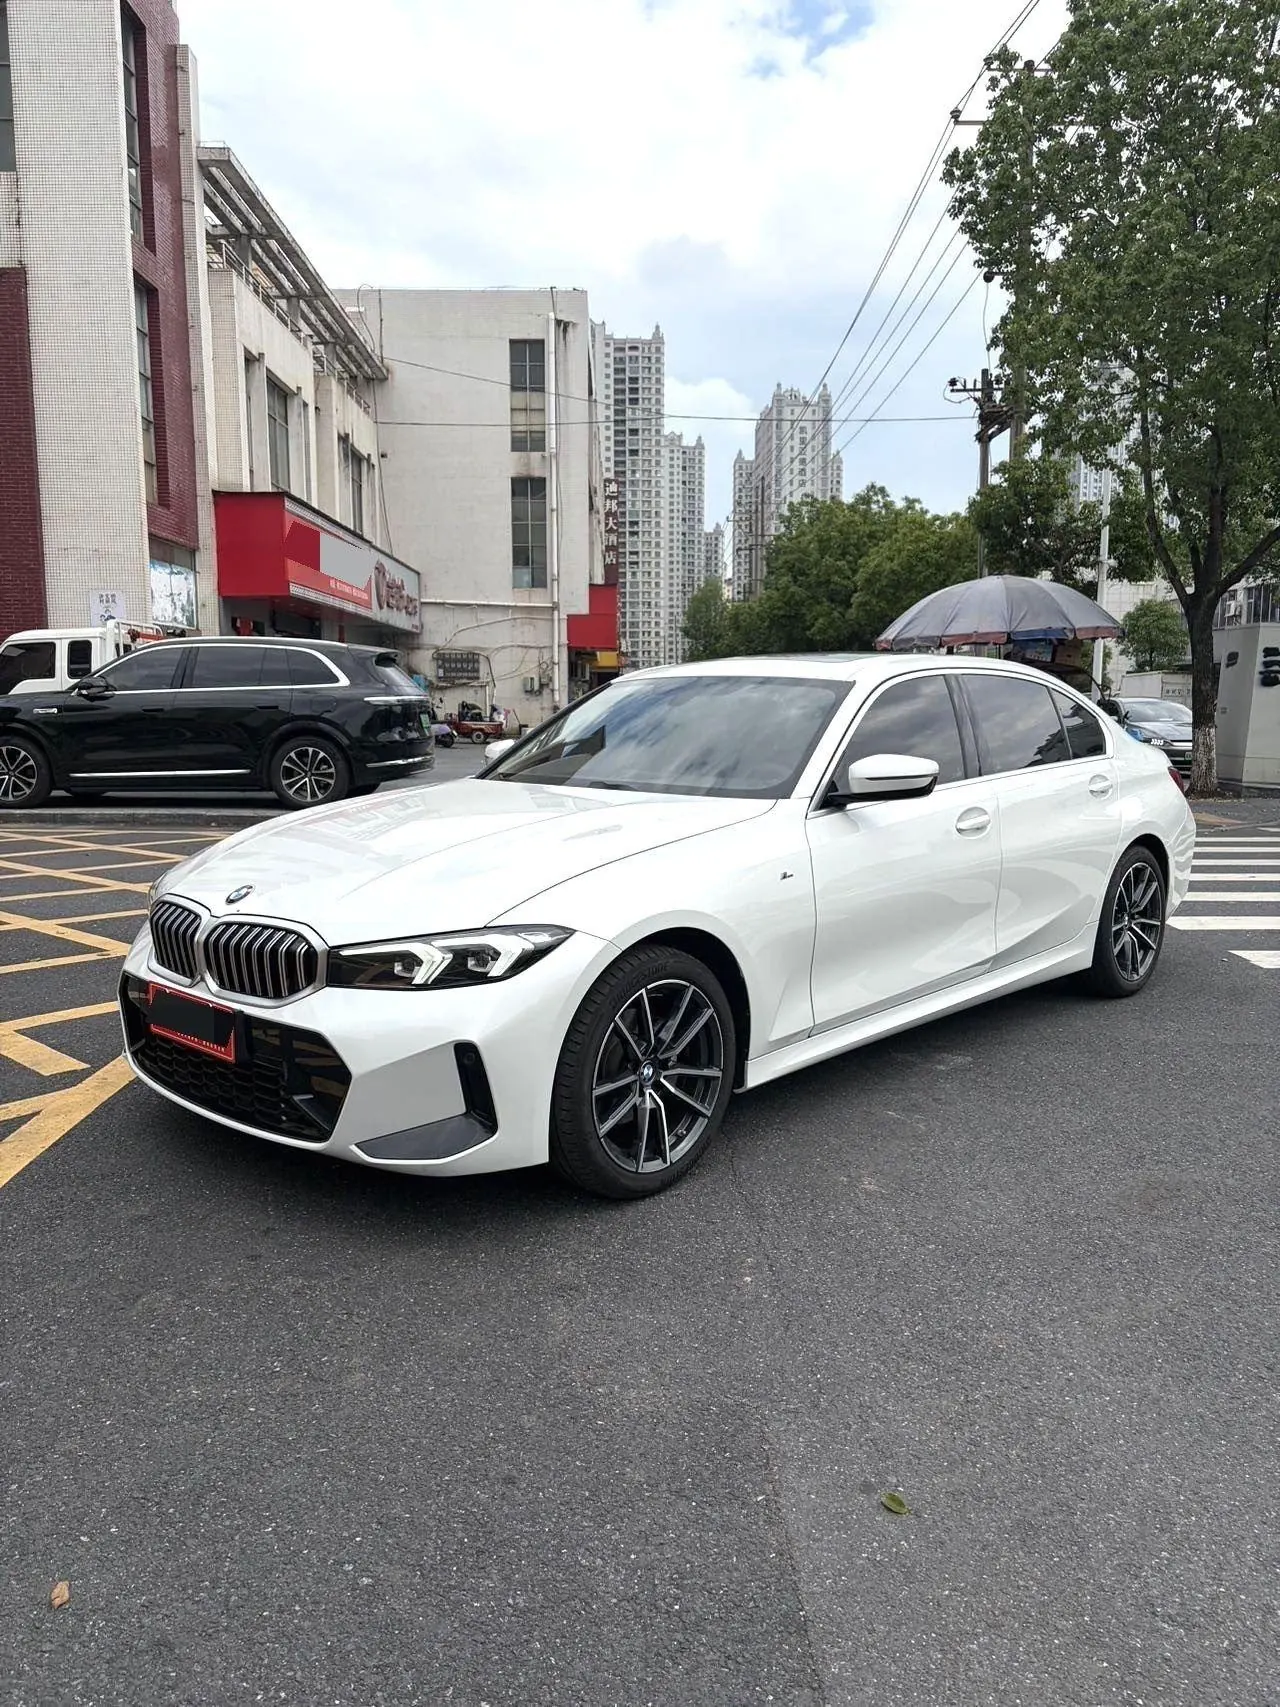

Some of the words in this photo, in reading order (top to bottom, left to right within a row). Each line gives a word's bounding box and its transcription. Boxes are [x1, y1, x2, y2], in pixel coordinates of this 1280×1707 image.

[604, 481, 618, 565] 迪邦大酒店
